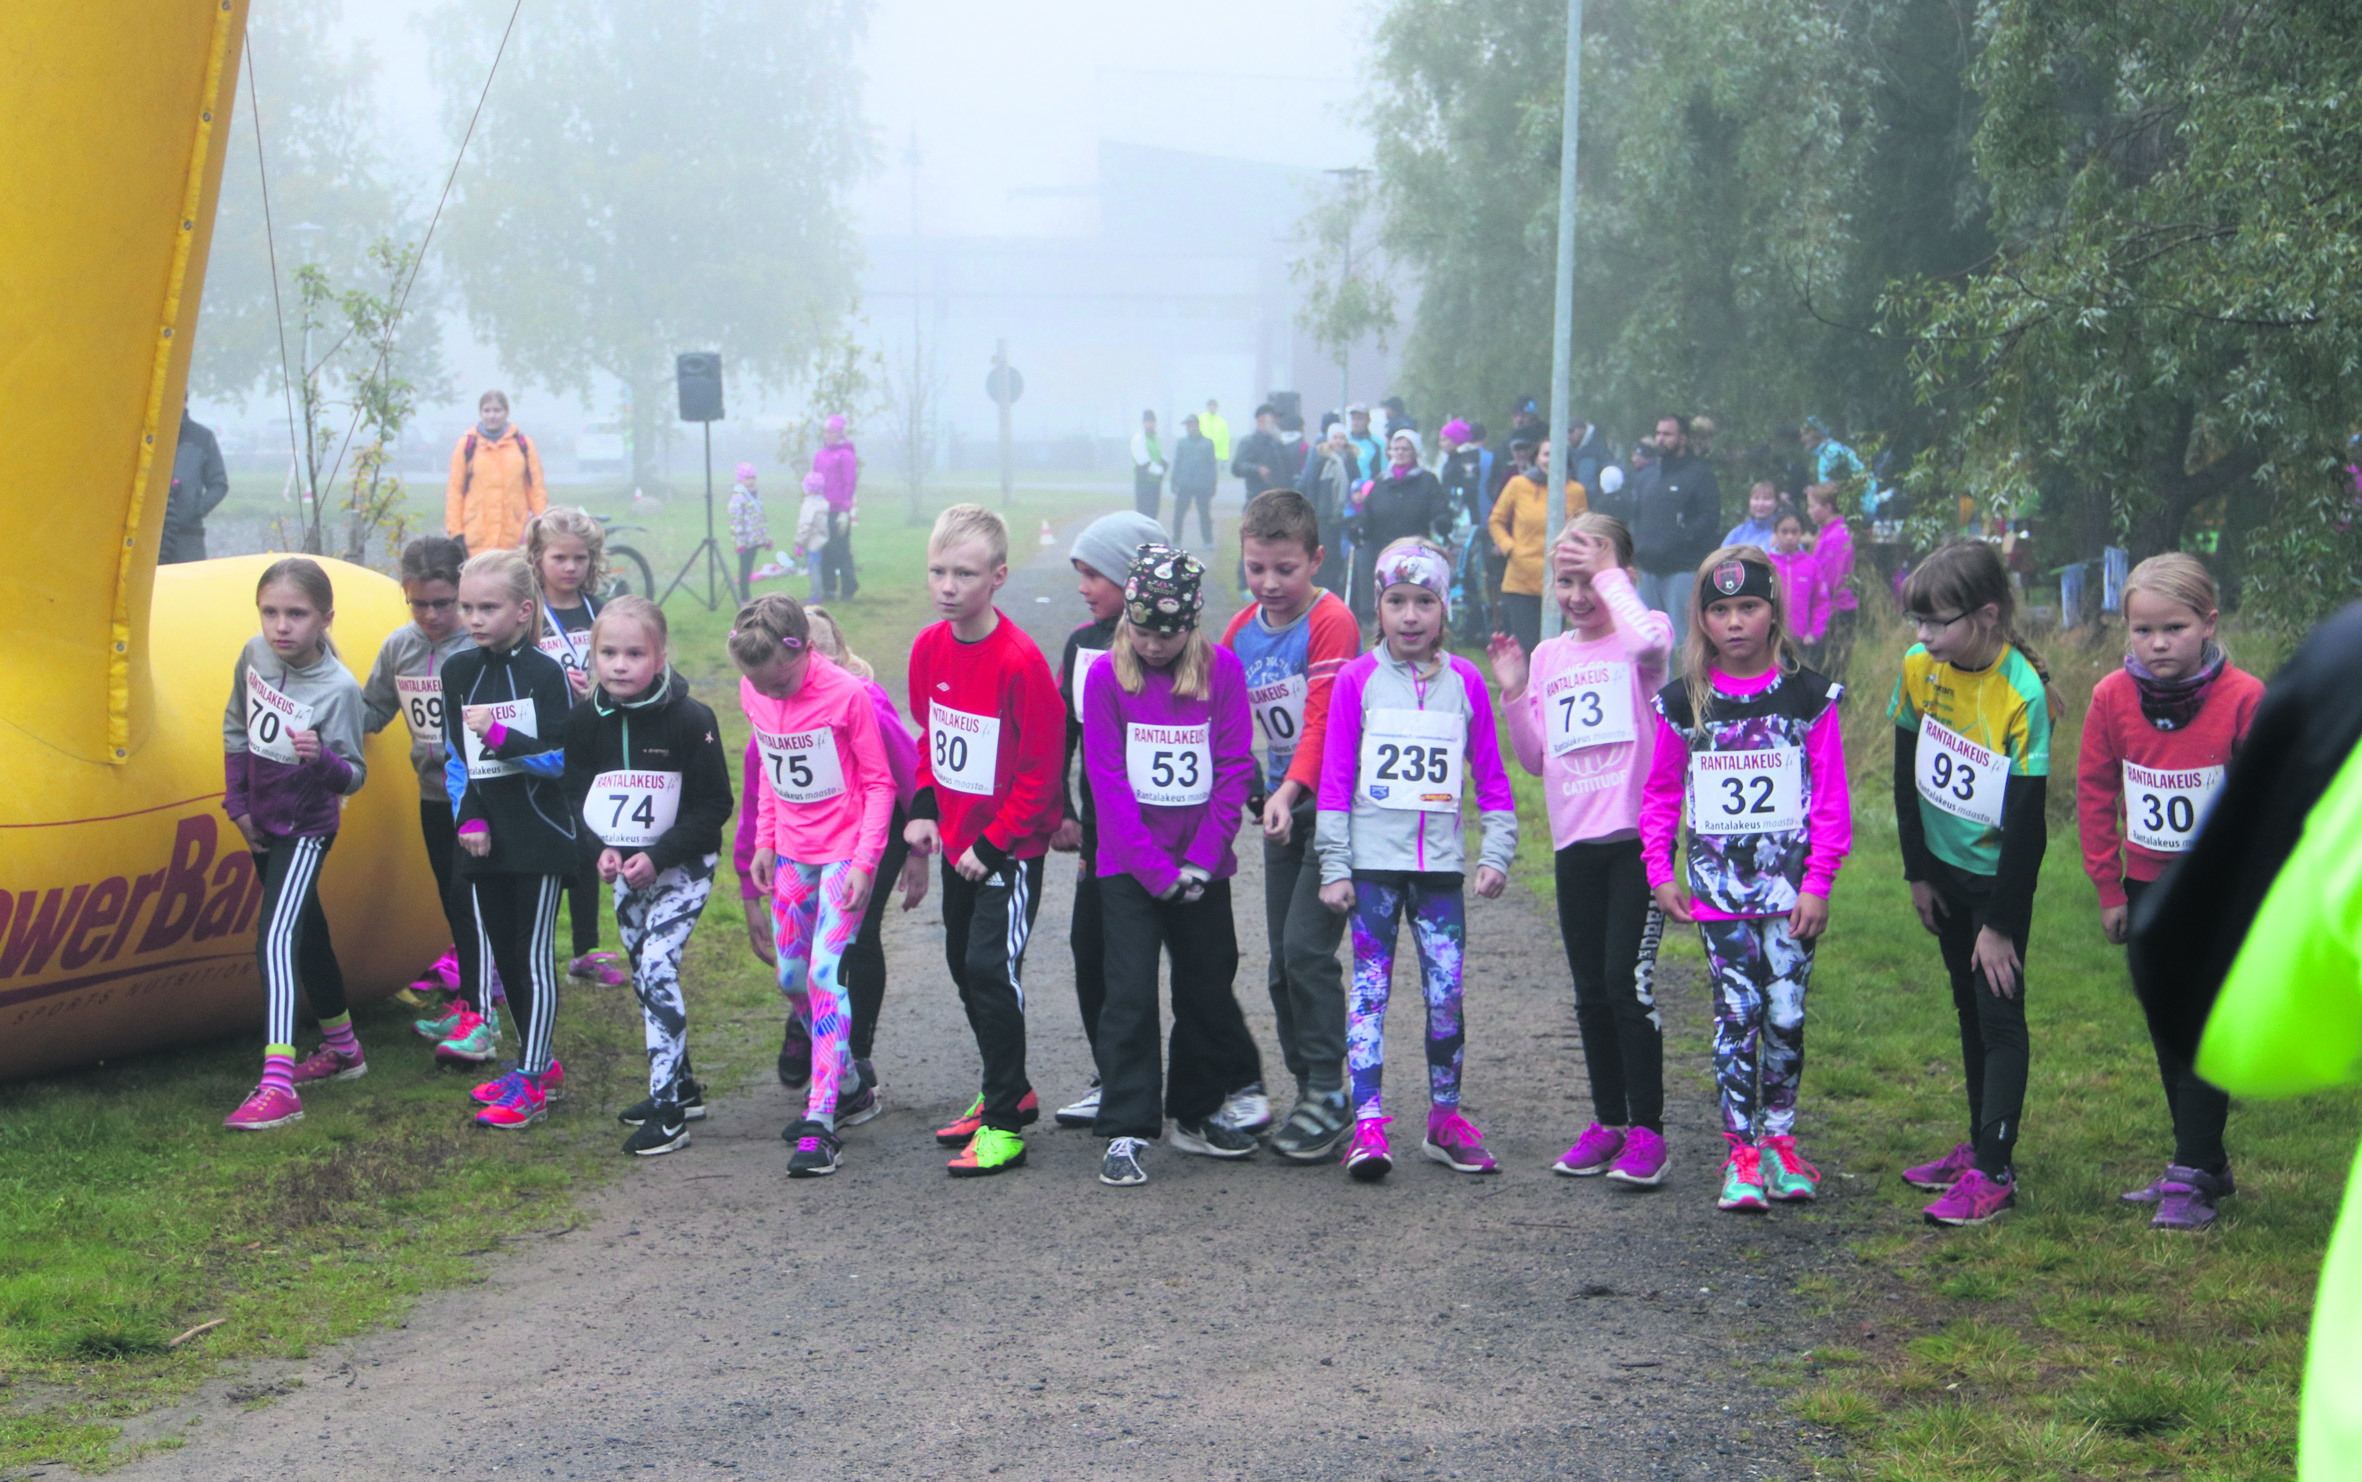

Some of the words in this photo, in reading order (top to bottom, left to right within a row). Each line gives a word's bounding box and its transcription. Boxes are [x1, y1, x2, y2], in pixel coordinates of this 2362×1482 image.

[249, 671, 294, 715] RANTALAKEUS
[399, 679, 443, 692] RANTALAKEU
[250, 698, 280, 744] 70
[411, 697, 443, 728] 69
[932, 706, 980, 733] NTALAKEUS
[1559, 691, 1603, 733] 73
[936, 730, 968, 772] 80
[1135, 728, 1205, 745] RANTALAKEUS
[1926, 720, 1990, 767] RANTALAKEUS
[767, 752, 813, 788] 75
[1152, 751, 1198, 788] 53
[1376, 743, 1448, 784] 235
[1701, 753, 1782, 771] RANTALAKEUS
[1932, 752, 1976, 801] 93
[2127, 765, 2201, 789] RANTALAKEUS
[597, 774, 665, 789] RANTALAKEUS
[1721, 776, 1776, 815] 32
[609, 795, 654, 829] 74
[1705, 820, 1761, 831] Rantalakeus
[2142, 793, 2194, 833] 30
[0, 813, 264, 979] werBar
